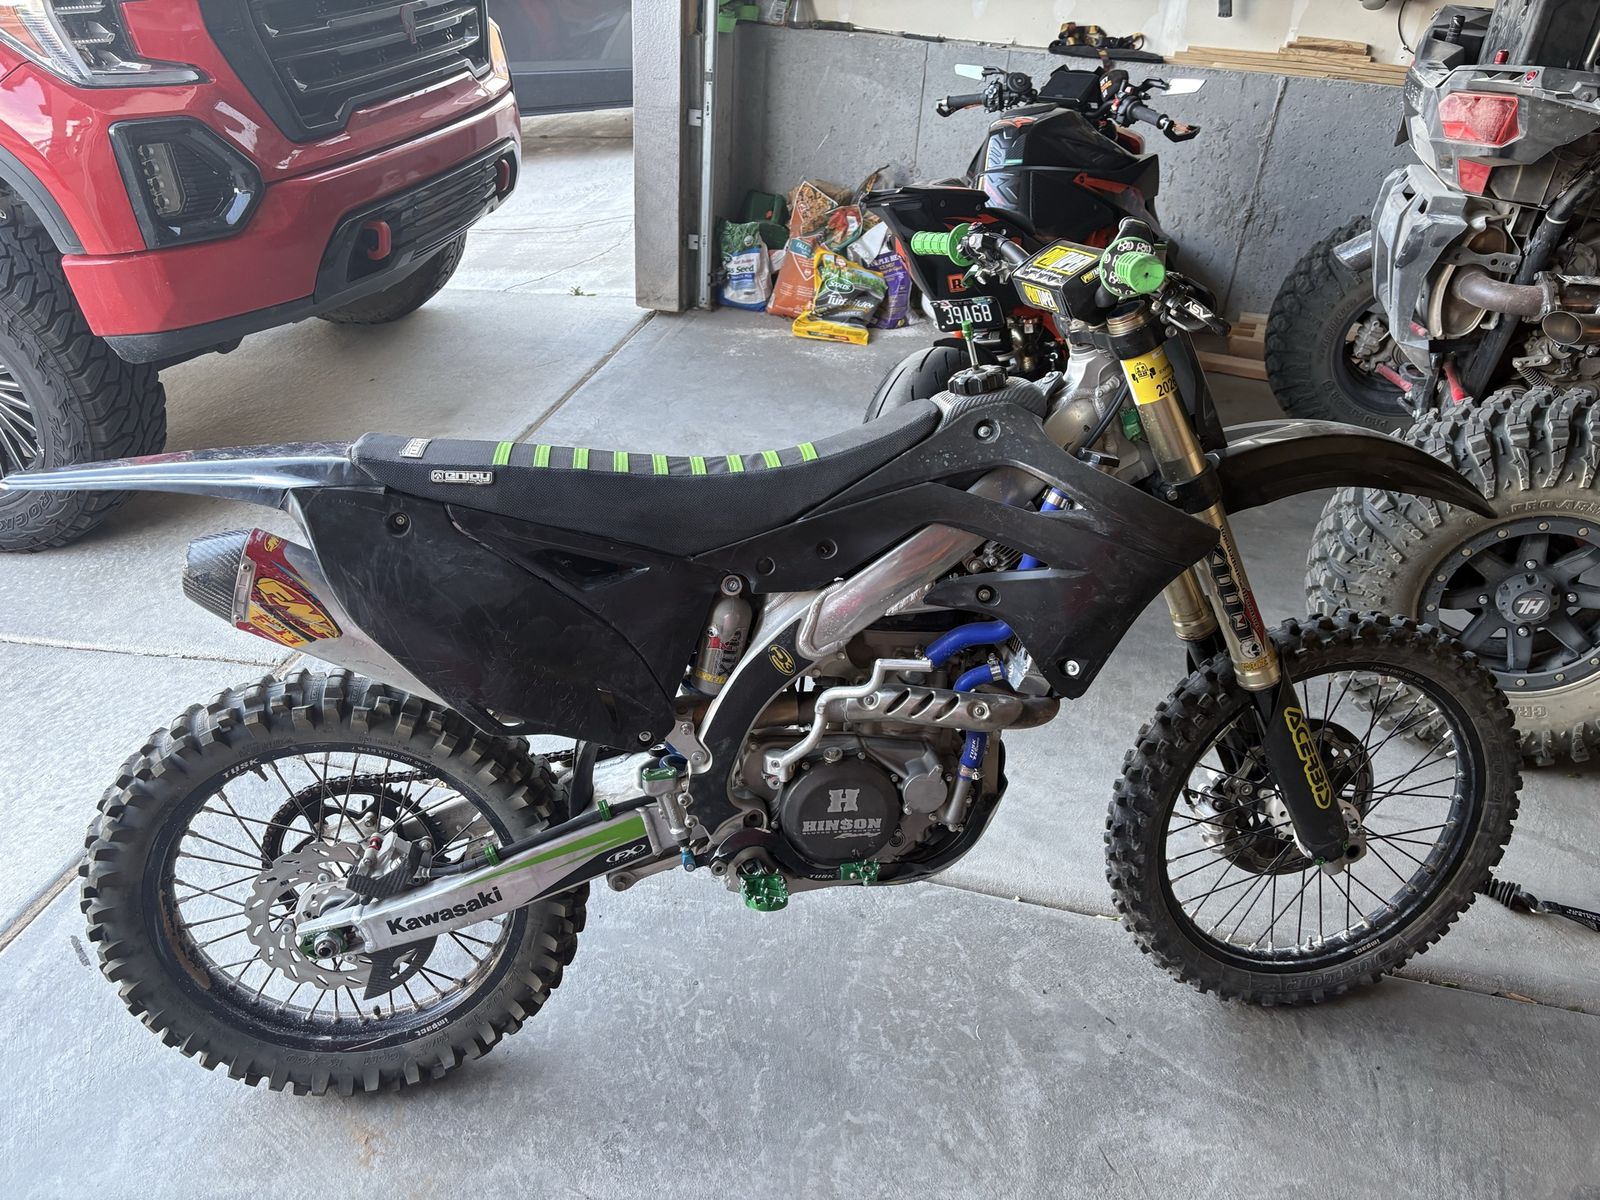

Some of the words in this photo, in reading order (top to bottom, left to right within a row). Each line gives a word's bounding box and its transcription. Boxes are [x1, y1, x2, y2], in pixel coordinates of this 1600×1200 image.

[736, 265, 754, 273] Seed
[829, 281, 851, 290] Scotts
[827, 294, 848, 305] Turf
[1184, 300, 1213, 318] ASV
[221, 757, 261, 780] TUSK
[802, 818, 882, 832] HINSON
[386, 886, 503, 936] Kawasaki
[413, 1017, 450, 1037] impact
